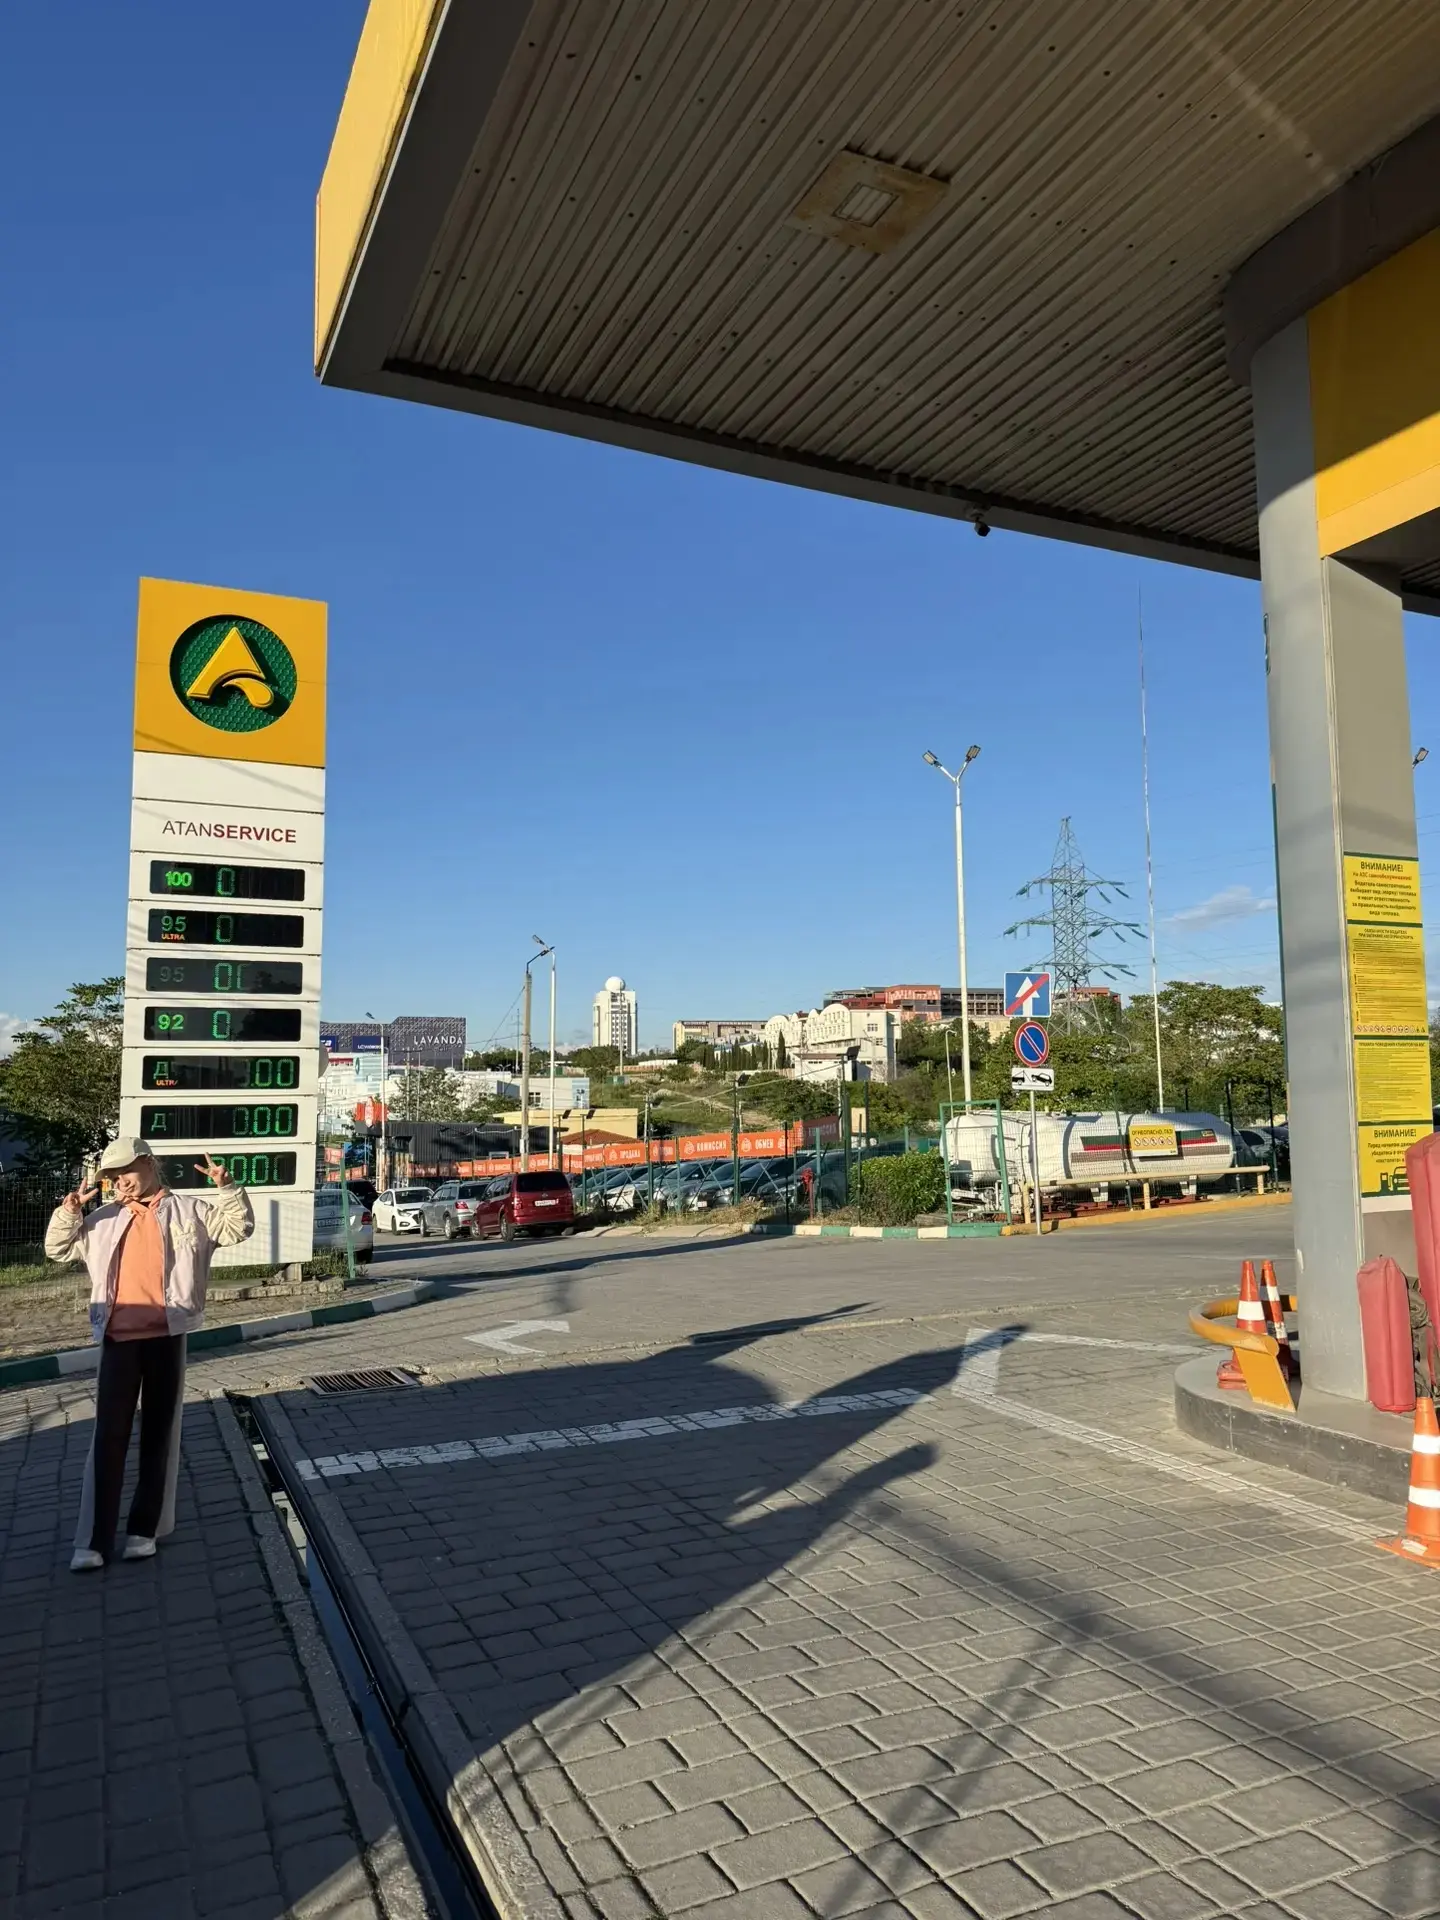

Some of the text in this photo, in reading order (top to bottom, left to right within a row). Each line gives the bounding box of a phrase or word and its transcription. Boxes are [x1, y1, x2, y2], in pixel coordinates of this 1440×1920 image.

[162, 820, 297, 843] ATANSERVICE
[1360, 861, 1403, 872] ВНИМАНИЕ!
[165, 871, 192, 887] 100
[161, 915, 187, 932] 95
[159, 966, 184, 982] 95
[158, 1014, 184, 1030] 92
[413, 1035, 463, 1046] LAVANDA
[1374, 1129, 1416, 1138] ВНИМАНИЕ!
[755, 1139, 774, 1150] ОБМЕН
